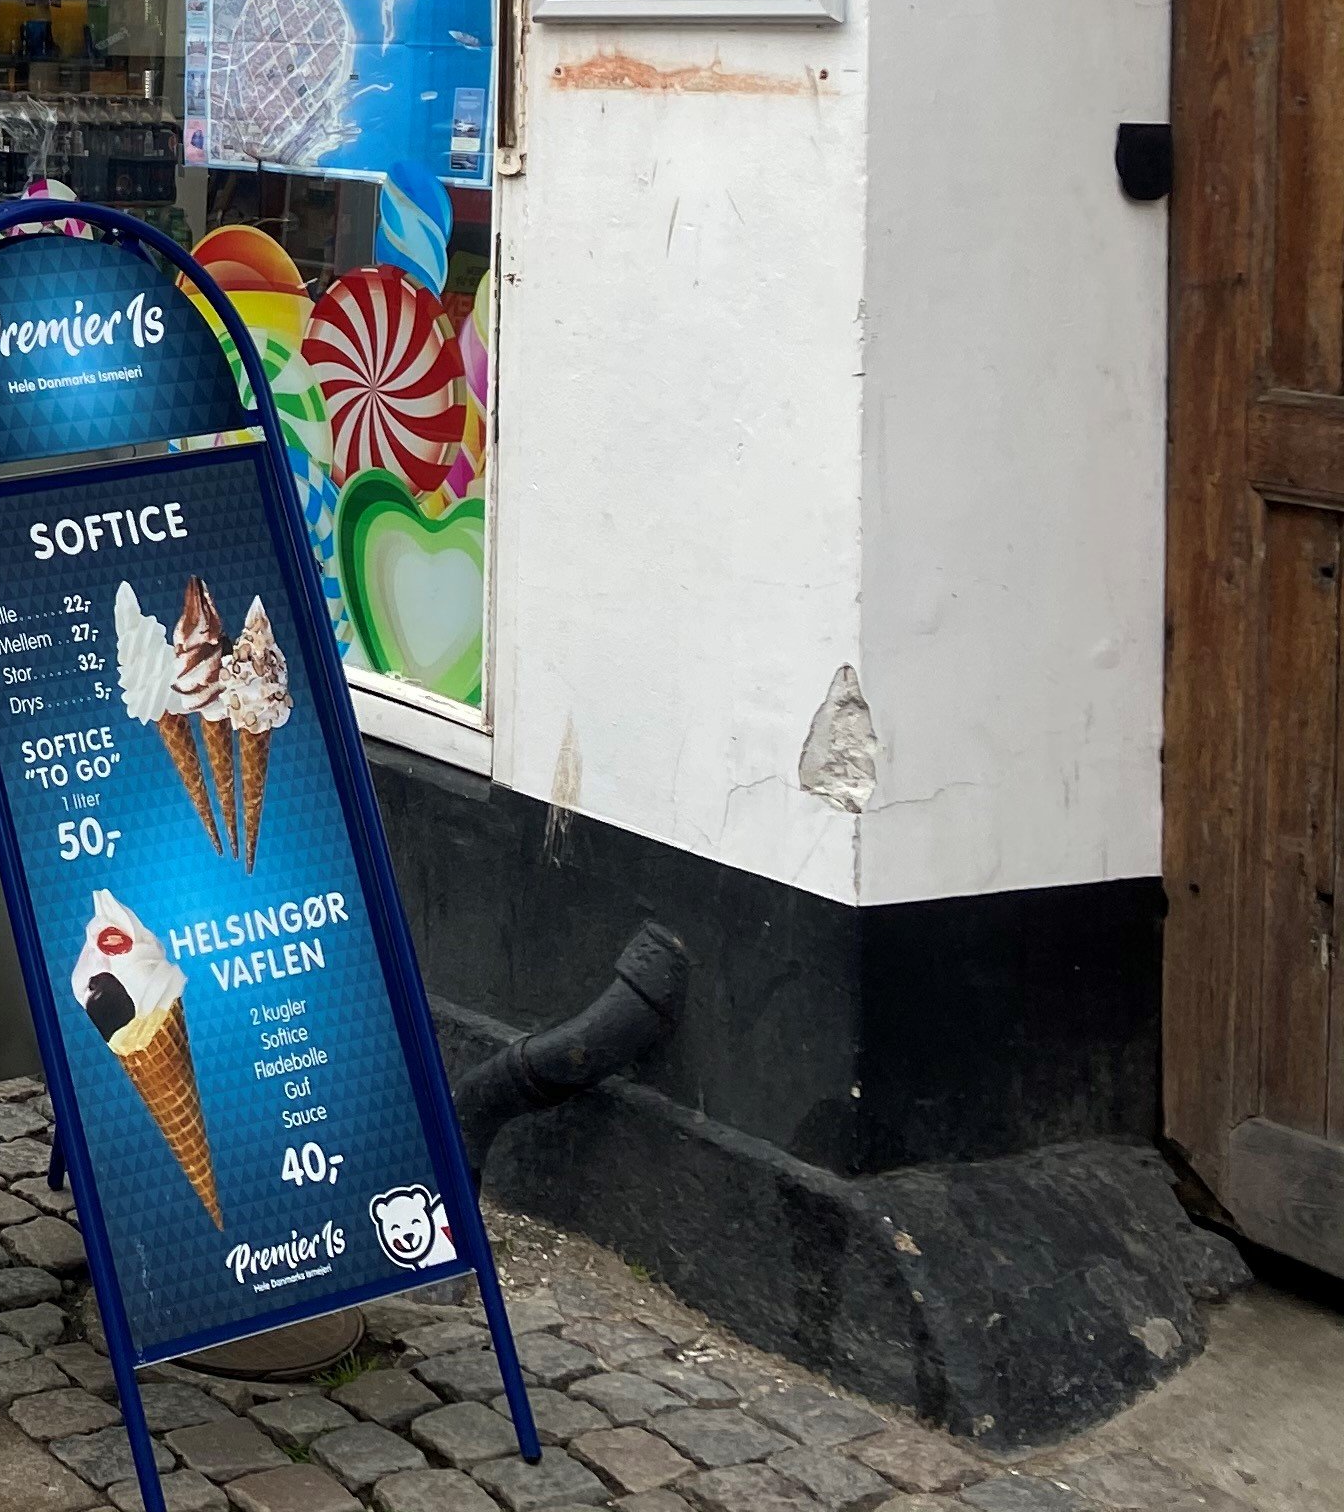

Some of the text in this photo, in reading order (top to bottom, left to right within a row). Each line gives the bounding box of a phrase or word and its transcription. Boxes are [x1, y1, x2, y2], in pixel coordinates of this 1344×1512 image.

[126, 292, 165, 348] Is
[7, 364, 143, 394] Hele Danmarks Ismejeri
[30, 502, 188, 560] SOFTICE
[3, 667, 32, 685] Stor
[9, 696, 44, 716] Drys
[21, 726, 115, 764] SOFTICE
[62, 793, 101, 812] 1 liter
[169, 891, 349, 960] HELSINGØR
[210, 938, 326, 991] VAFLEN
[250, 998, 307, 1026] 2 kugler
[261, 1026, 309, 1051] Softice
[254, 1046, 329, 1080] Flødebolle
[284, 1076, 312, 1100] Guf
[282, 1104, 328, 1129] Sauce
[225, 1219, 346, 1284] Premier Is
